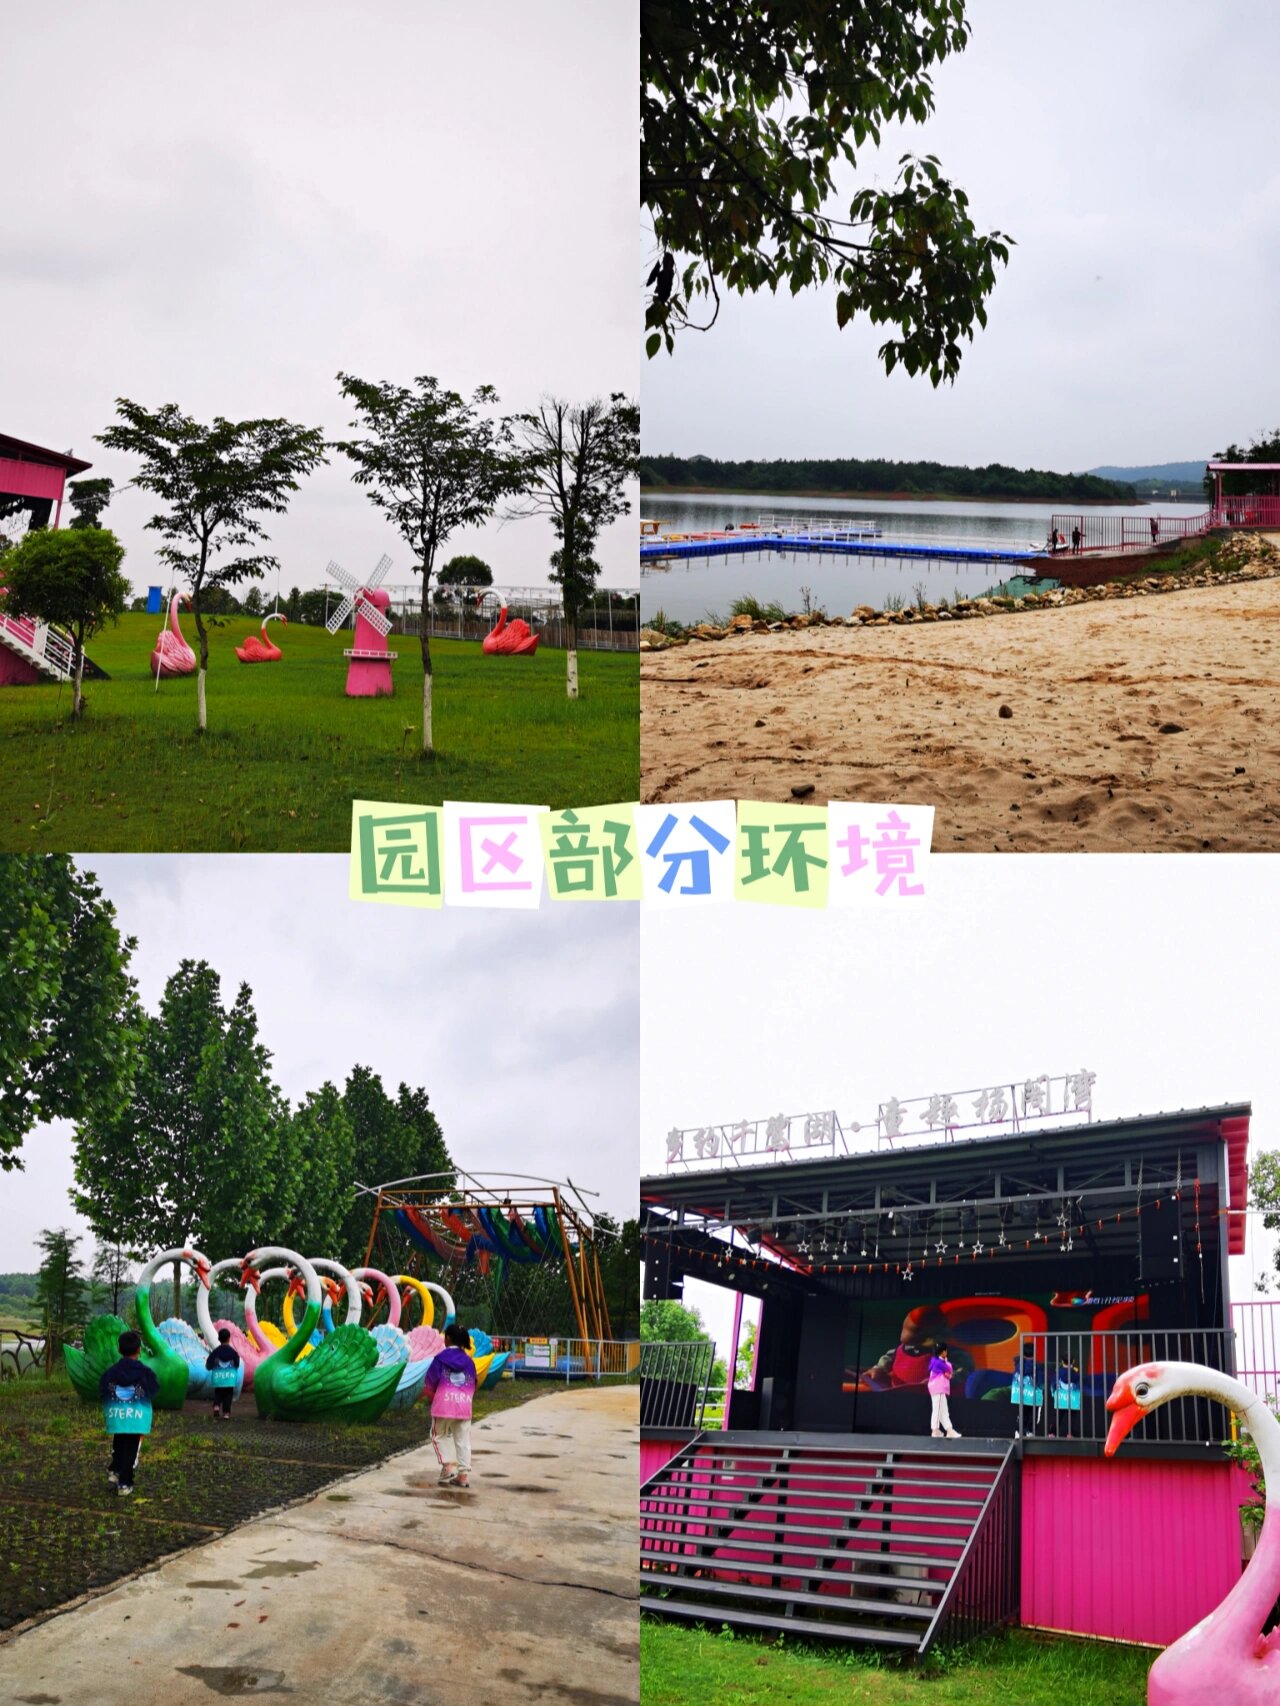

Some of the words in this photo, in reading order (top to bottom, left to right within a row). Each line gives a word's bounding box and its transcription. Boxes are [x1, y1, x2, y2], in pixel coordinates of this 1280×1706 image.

[215, 1371, 235, 1380] STERN
[443, 1391, 473, 1405] STERN
[108, 1407, 143, 1420] STERN
